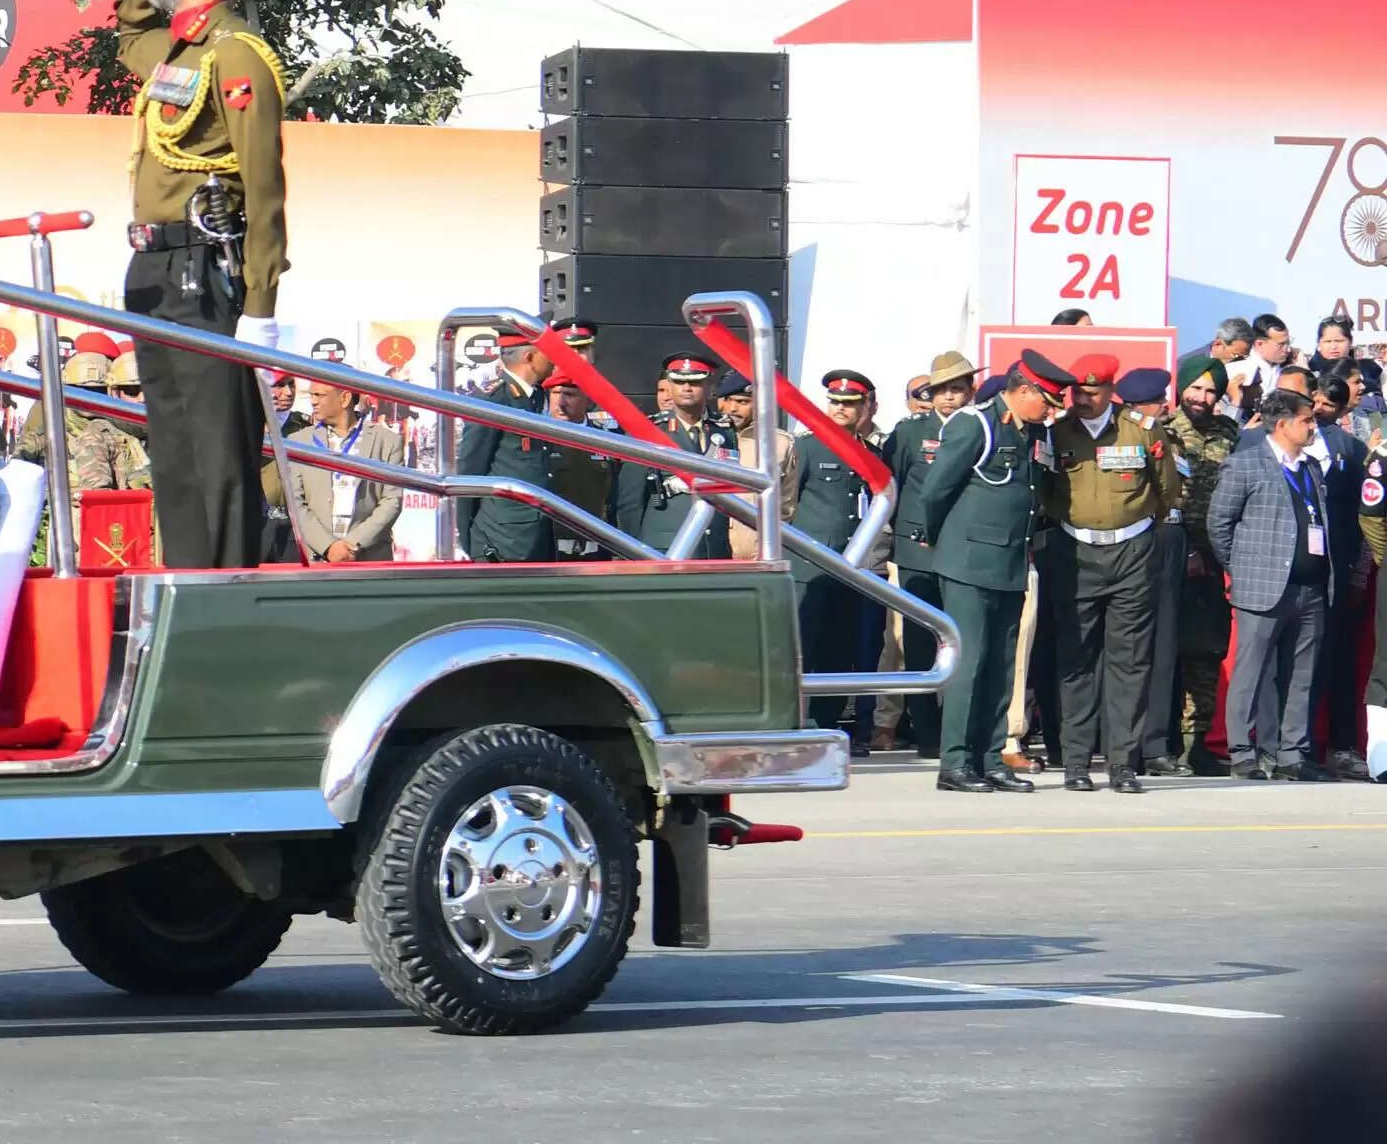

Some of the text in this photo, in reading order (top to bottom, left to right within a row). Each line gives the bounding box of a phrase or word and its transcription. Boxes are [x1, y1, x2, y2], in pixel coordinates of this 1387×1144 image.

[1030, 188, 1154, 236] Zone
[1060, 253, 1121, 299] 2A
[1330, 298, 1387, 331] AR
